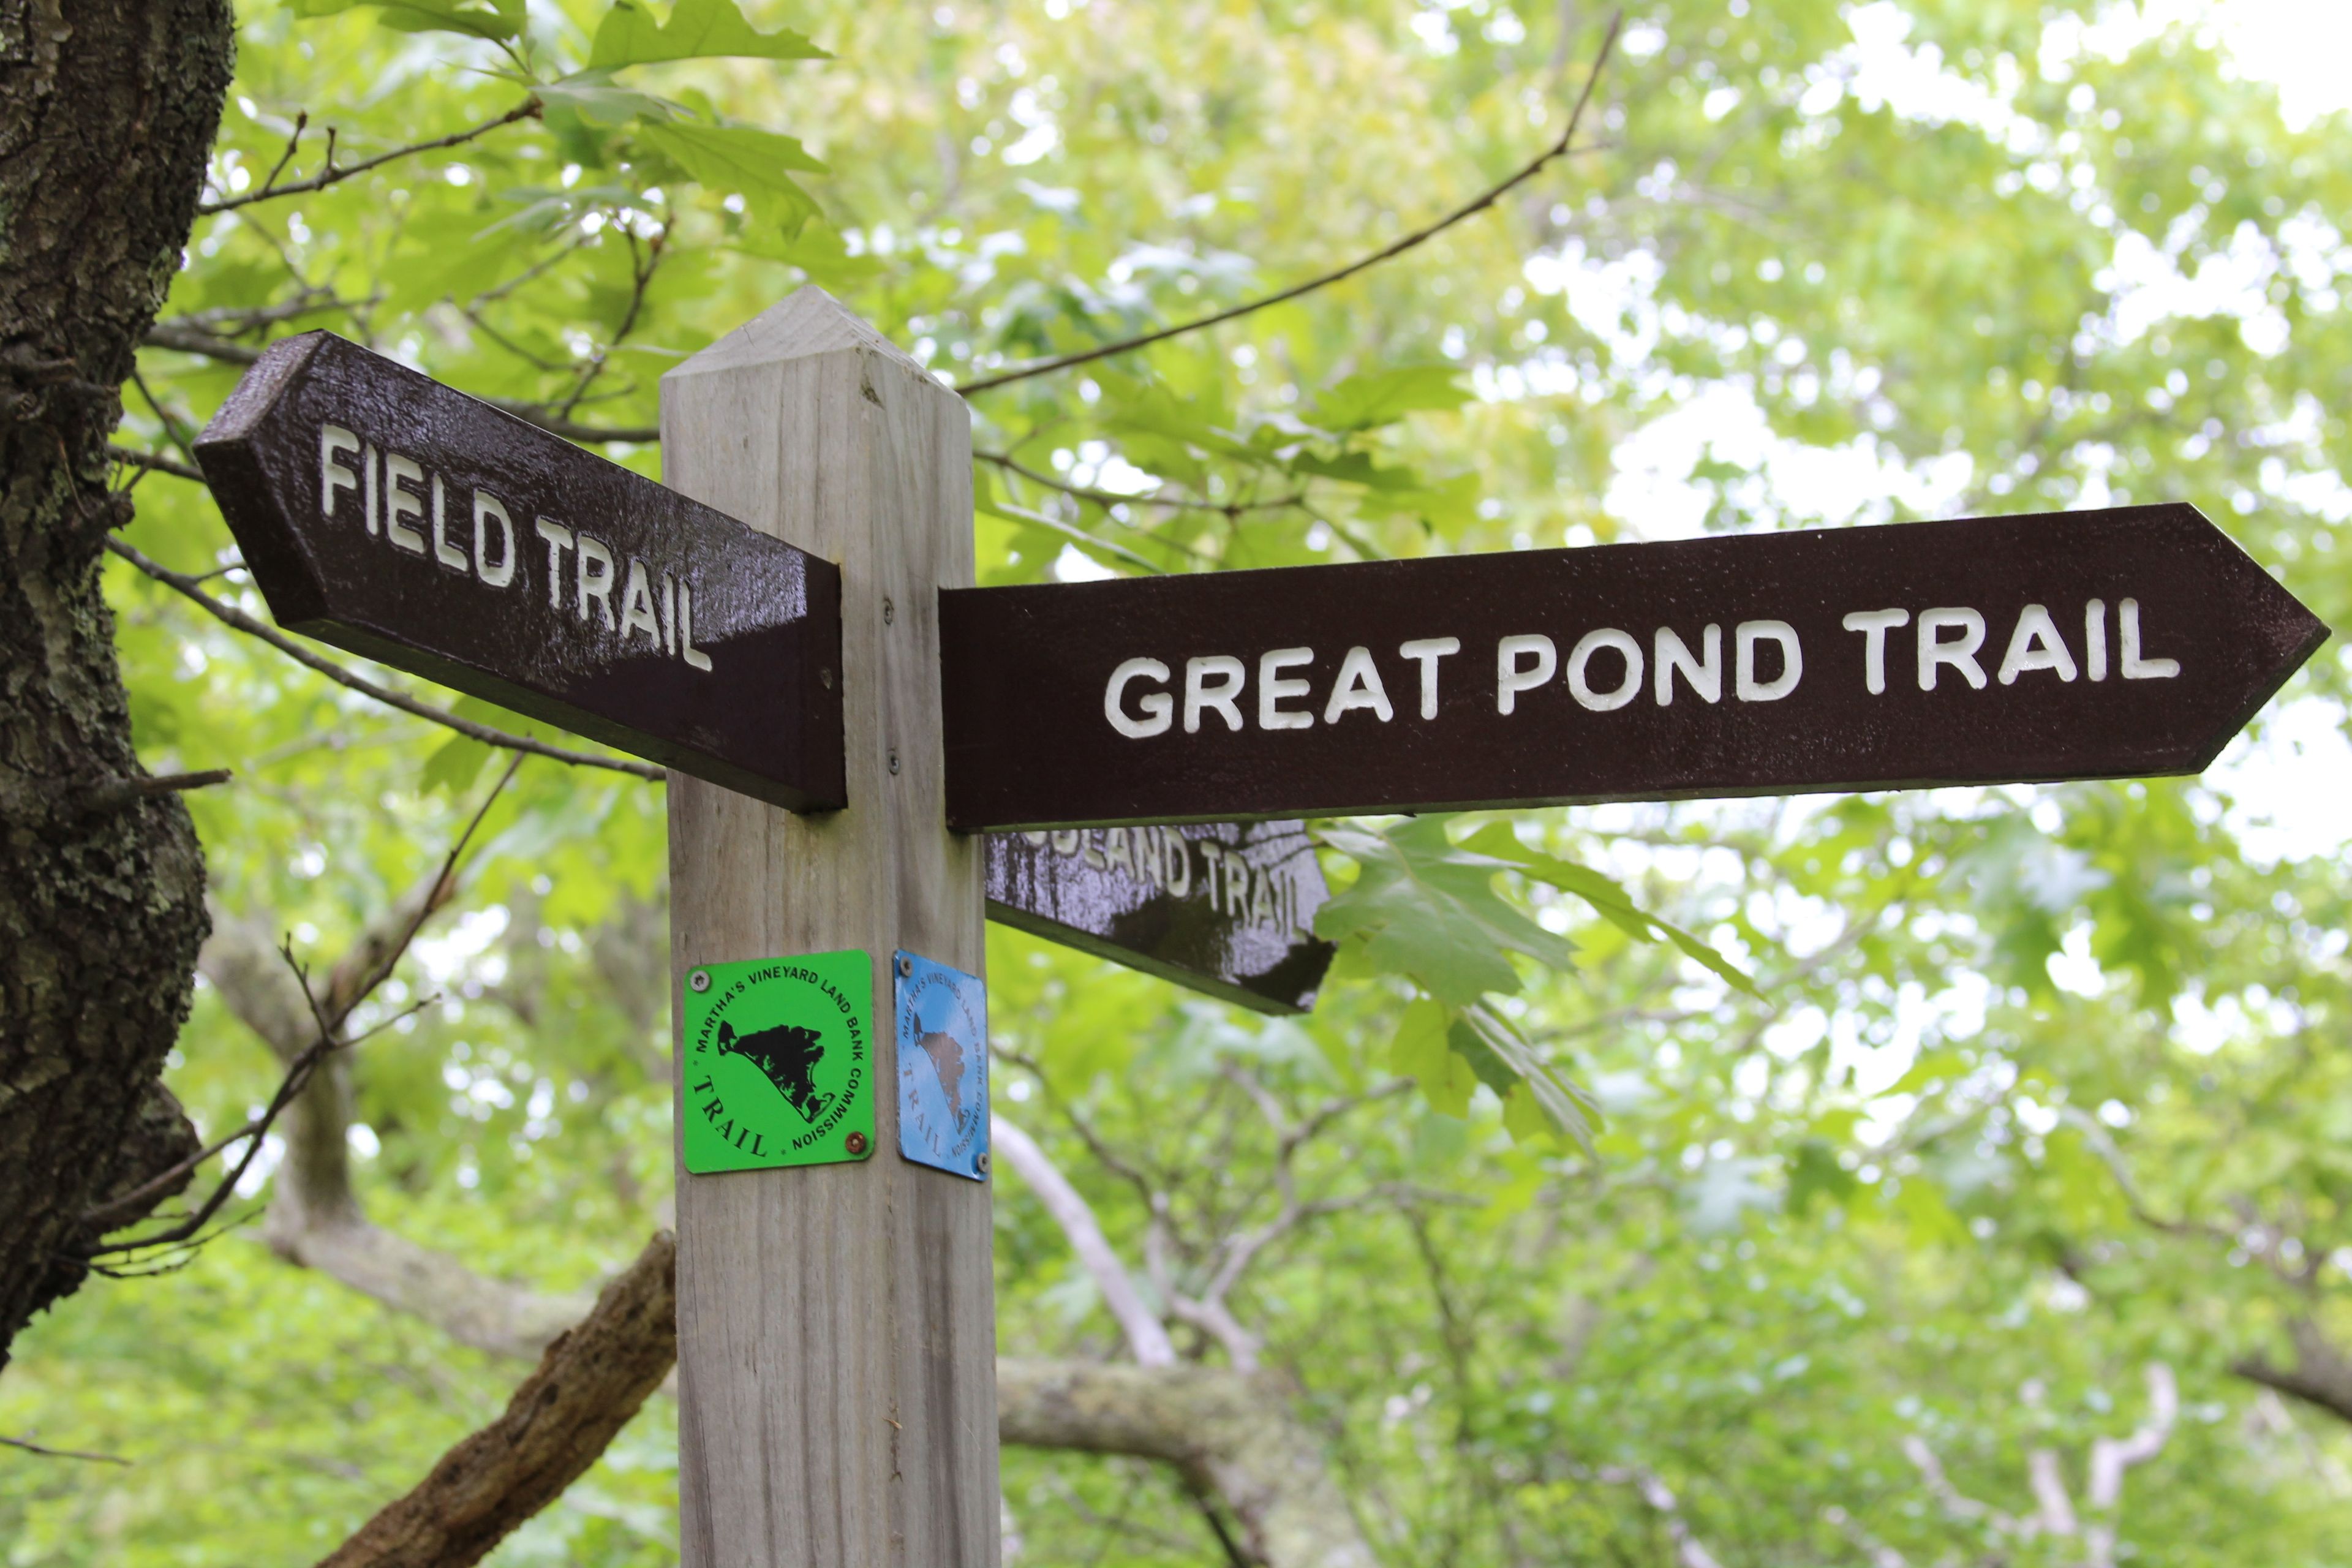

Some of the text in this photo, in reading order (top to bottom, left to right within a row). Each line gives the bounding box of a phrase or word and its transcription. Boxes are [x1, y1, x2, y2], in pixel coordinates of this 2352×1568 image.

[322, 423, 712, 671] FIELD TRAIL
[1105, 597, 2180, 739] GREAT POND TRAIL
[1200, 841, 1308, 944] TRAIL
[903, 978, 926, 1039] MARTHA'S
[927, 972, 961, 1000] VINEYARD
[696, 966, 864, 1151] MARTHA'S VINEYARD LAND BANK COMMISSION
[693, 1075, 768, 1157] TRAIL
[903, 1063, 941, 1158] TRAIL
